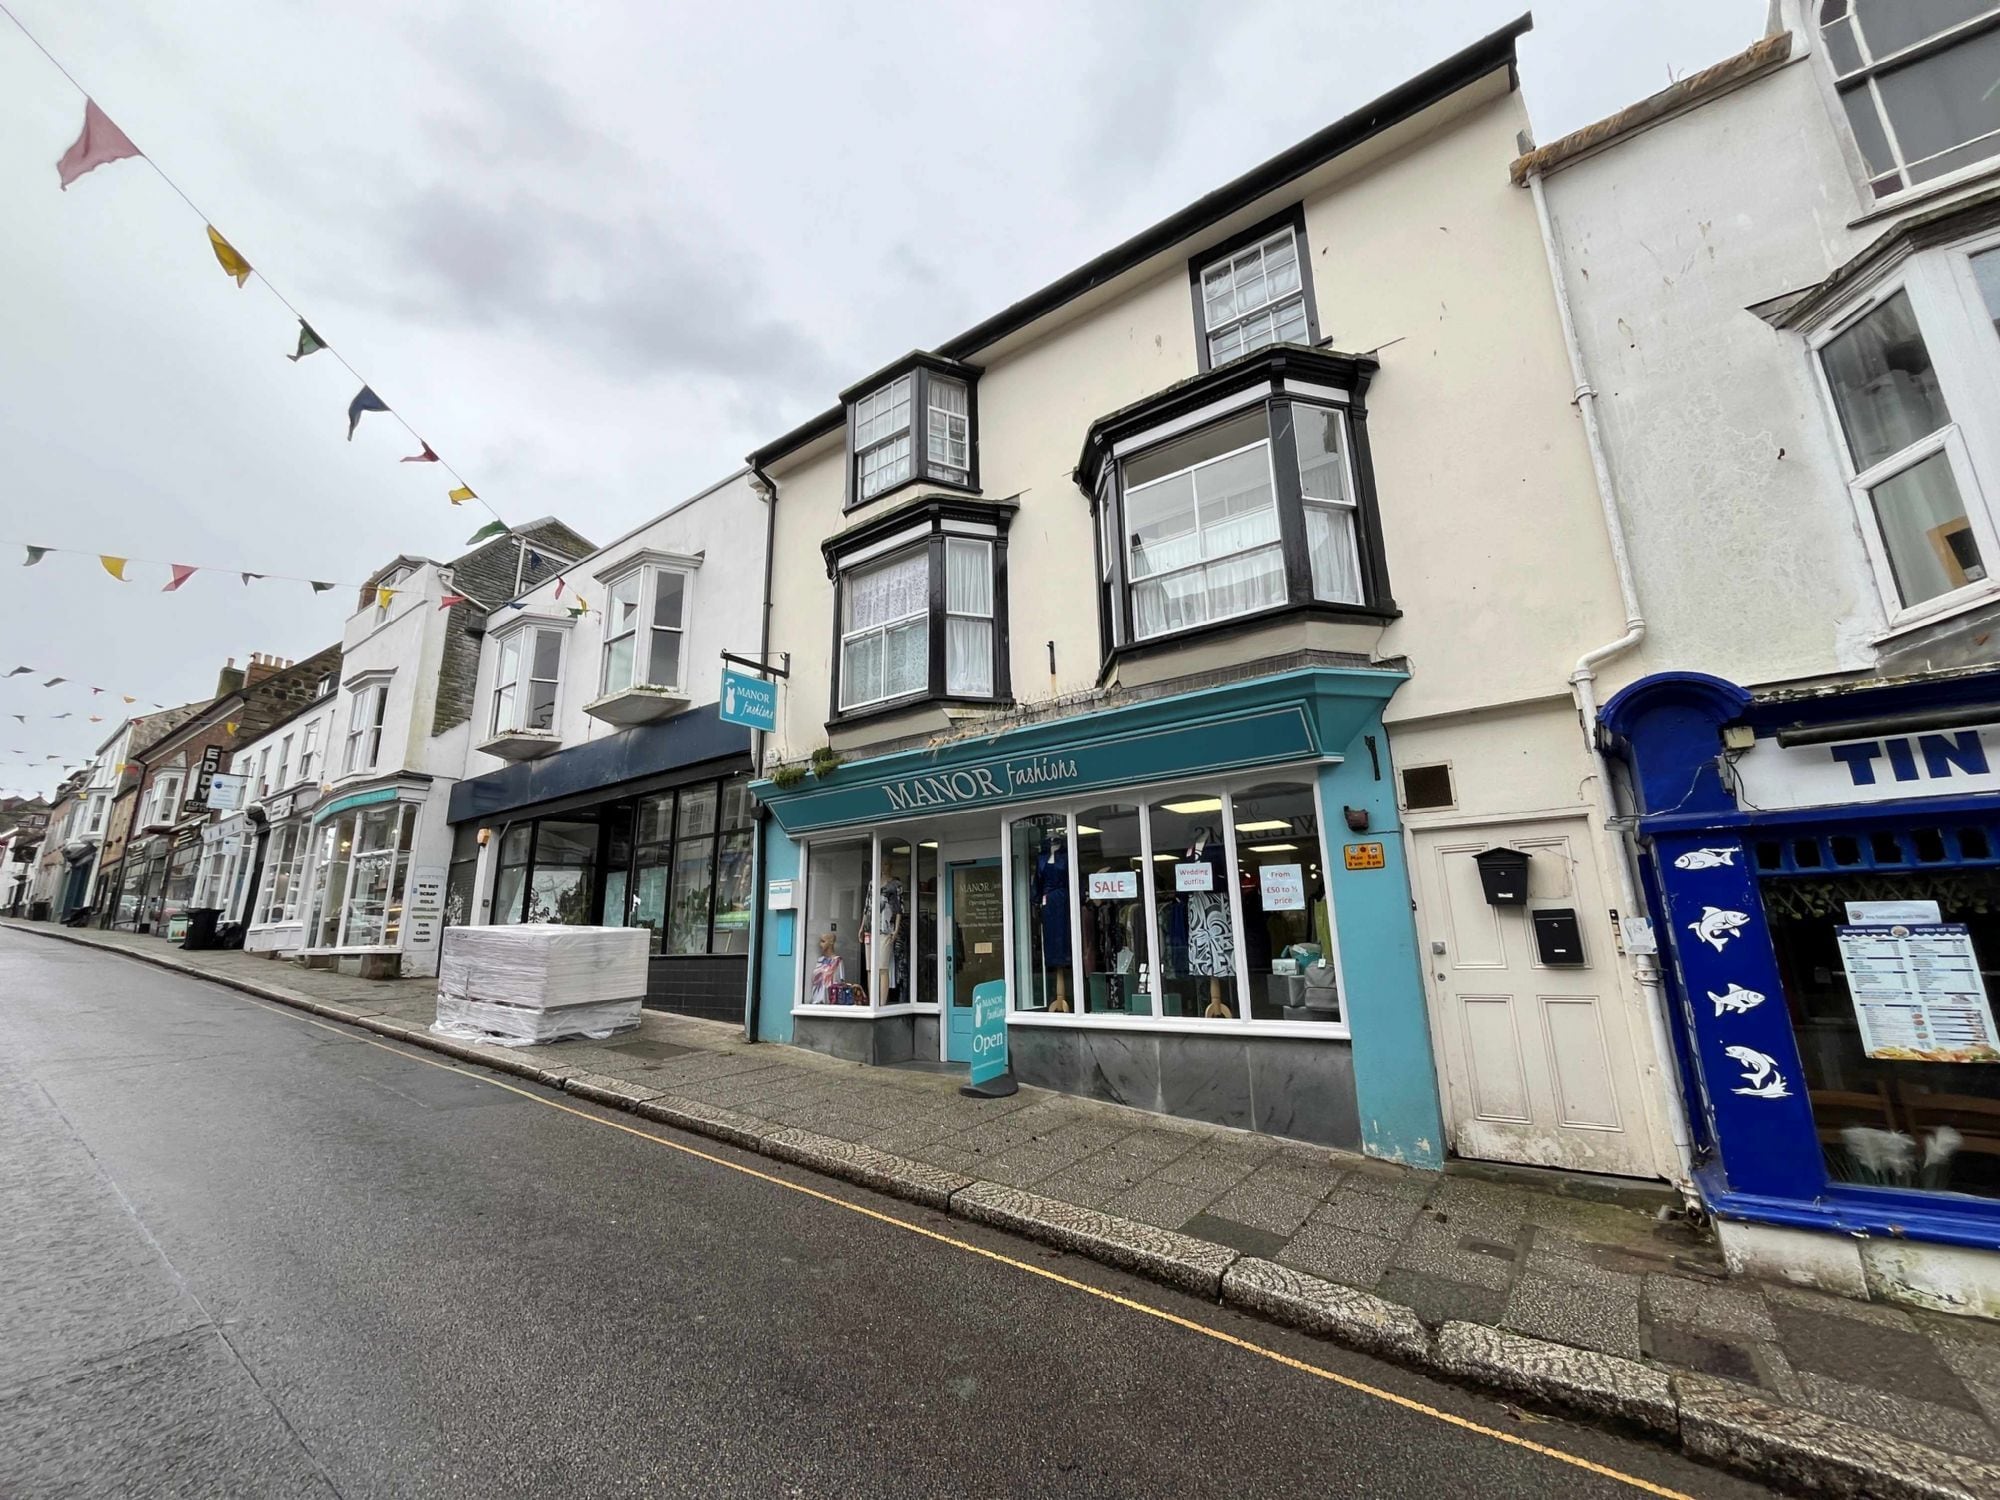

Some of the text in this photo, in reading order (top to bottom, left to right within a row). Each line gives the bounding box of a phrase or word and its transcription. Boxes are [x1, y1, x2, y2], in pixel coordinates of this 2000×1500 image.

[736, 686, 770, 704] MANOR
[1830, 730, 1991, 786] TIN
[200, 748, 221, 800] EDDY
[882, 757, 1078, 811] MANOR fashions
[1179, 869, 1208, 878] Wedding
[959, 882, 991, 894] MANOR
[1094, 880, 1125, 893] SALE
[1266, 886, 1280, 894] £50
[1274, 897, 1293, 905] price
[973, 1032, 1003, 1056] Open
